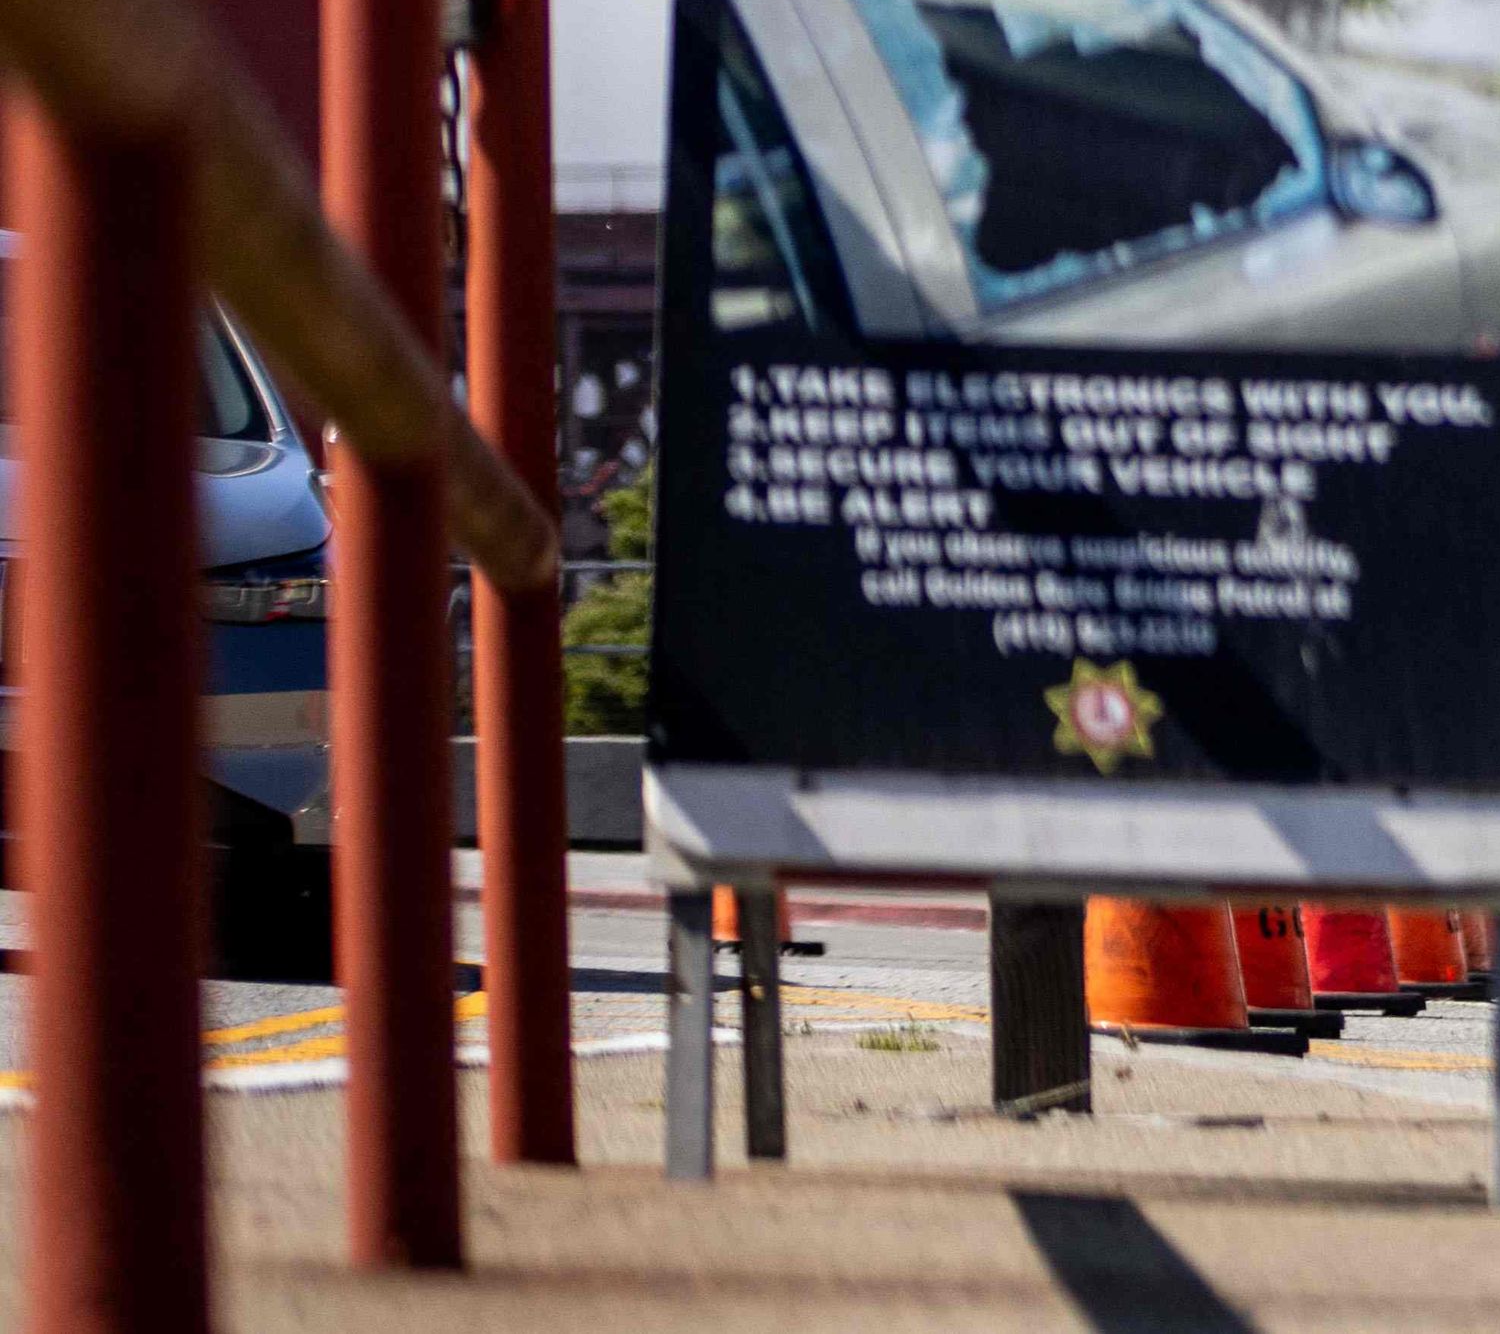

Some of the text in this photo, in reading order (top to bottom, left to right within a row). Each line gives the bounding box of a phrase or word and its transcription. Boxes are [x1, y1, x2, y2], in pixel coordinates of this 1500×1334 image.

[906, 369, 1232, 415] ELECTRONICS
[1241, 379, 1370, 421] WITH
[905, 409, 1050, 451] ITEMS
[1061, 413, 1159, 453] OUT
[1172, 418, 1235, 457] OF
[1247, 420, 1395, 463] SIGHT
[969, 450, 1102, 493] YOUR
[1110, 456, 1316, 499] VEHICLE
[841, 485, 994, 529] ALERT
[884, 531, 942, 567] you
